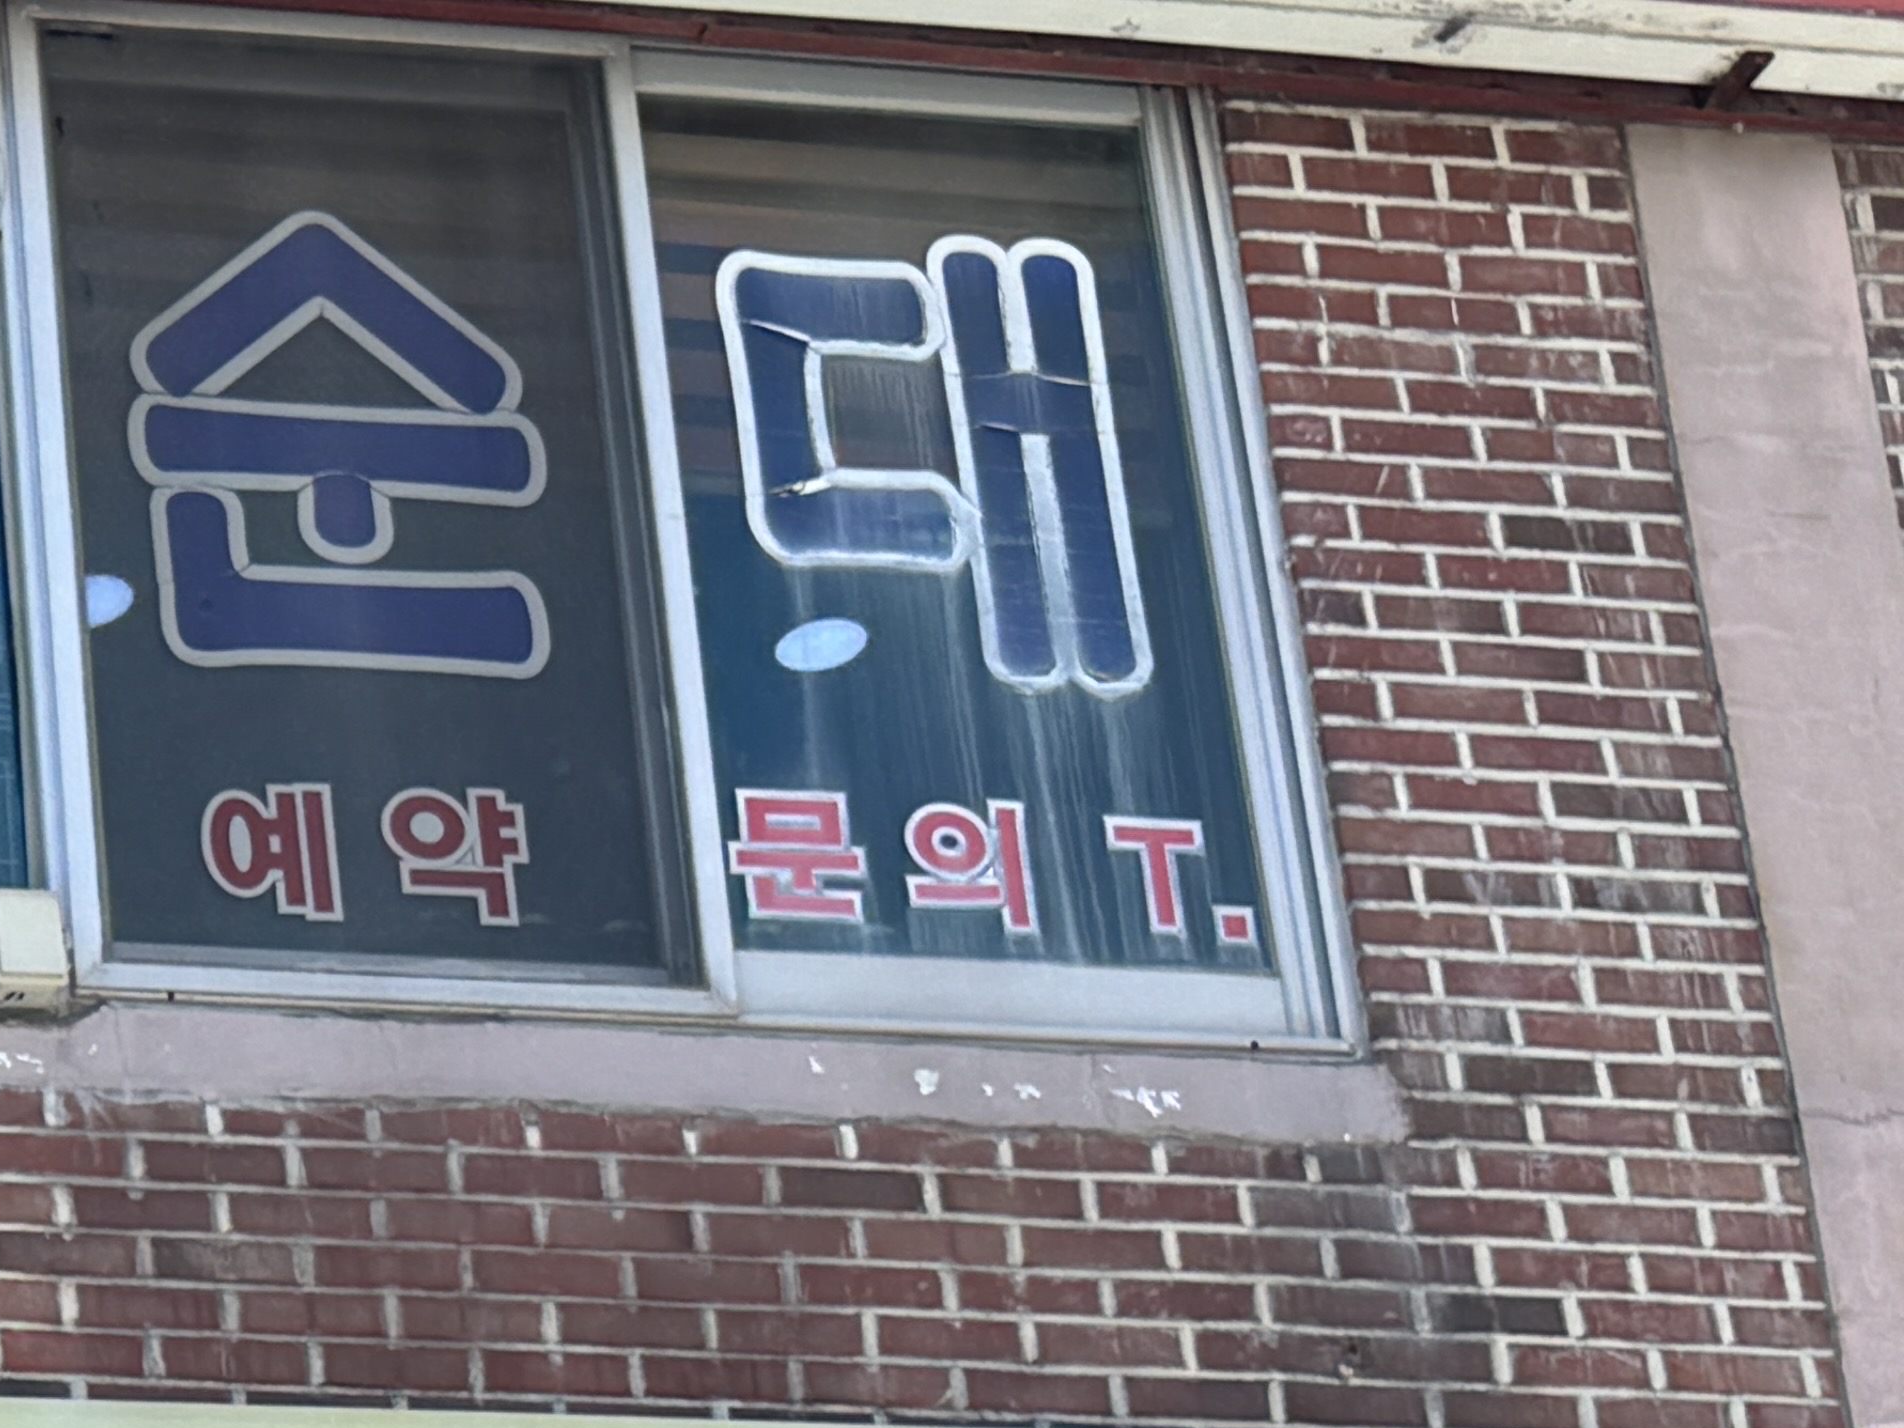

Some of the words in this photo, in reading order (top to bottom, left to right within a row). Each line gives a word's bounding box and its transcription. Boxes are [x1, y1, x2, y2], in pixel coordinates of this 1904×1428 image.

[127, 208, 1157, 700] 순대
[200, 780, 529, 928] 예약
[727, 787, 1037, 937] 문의
